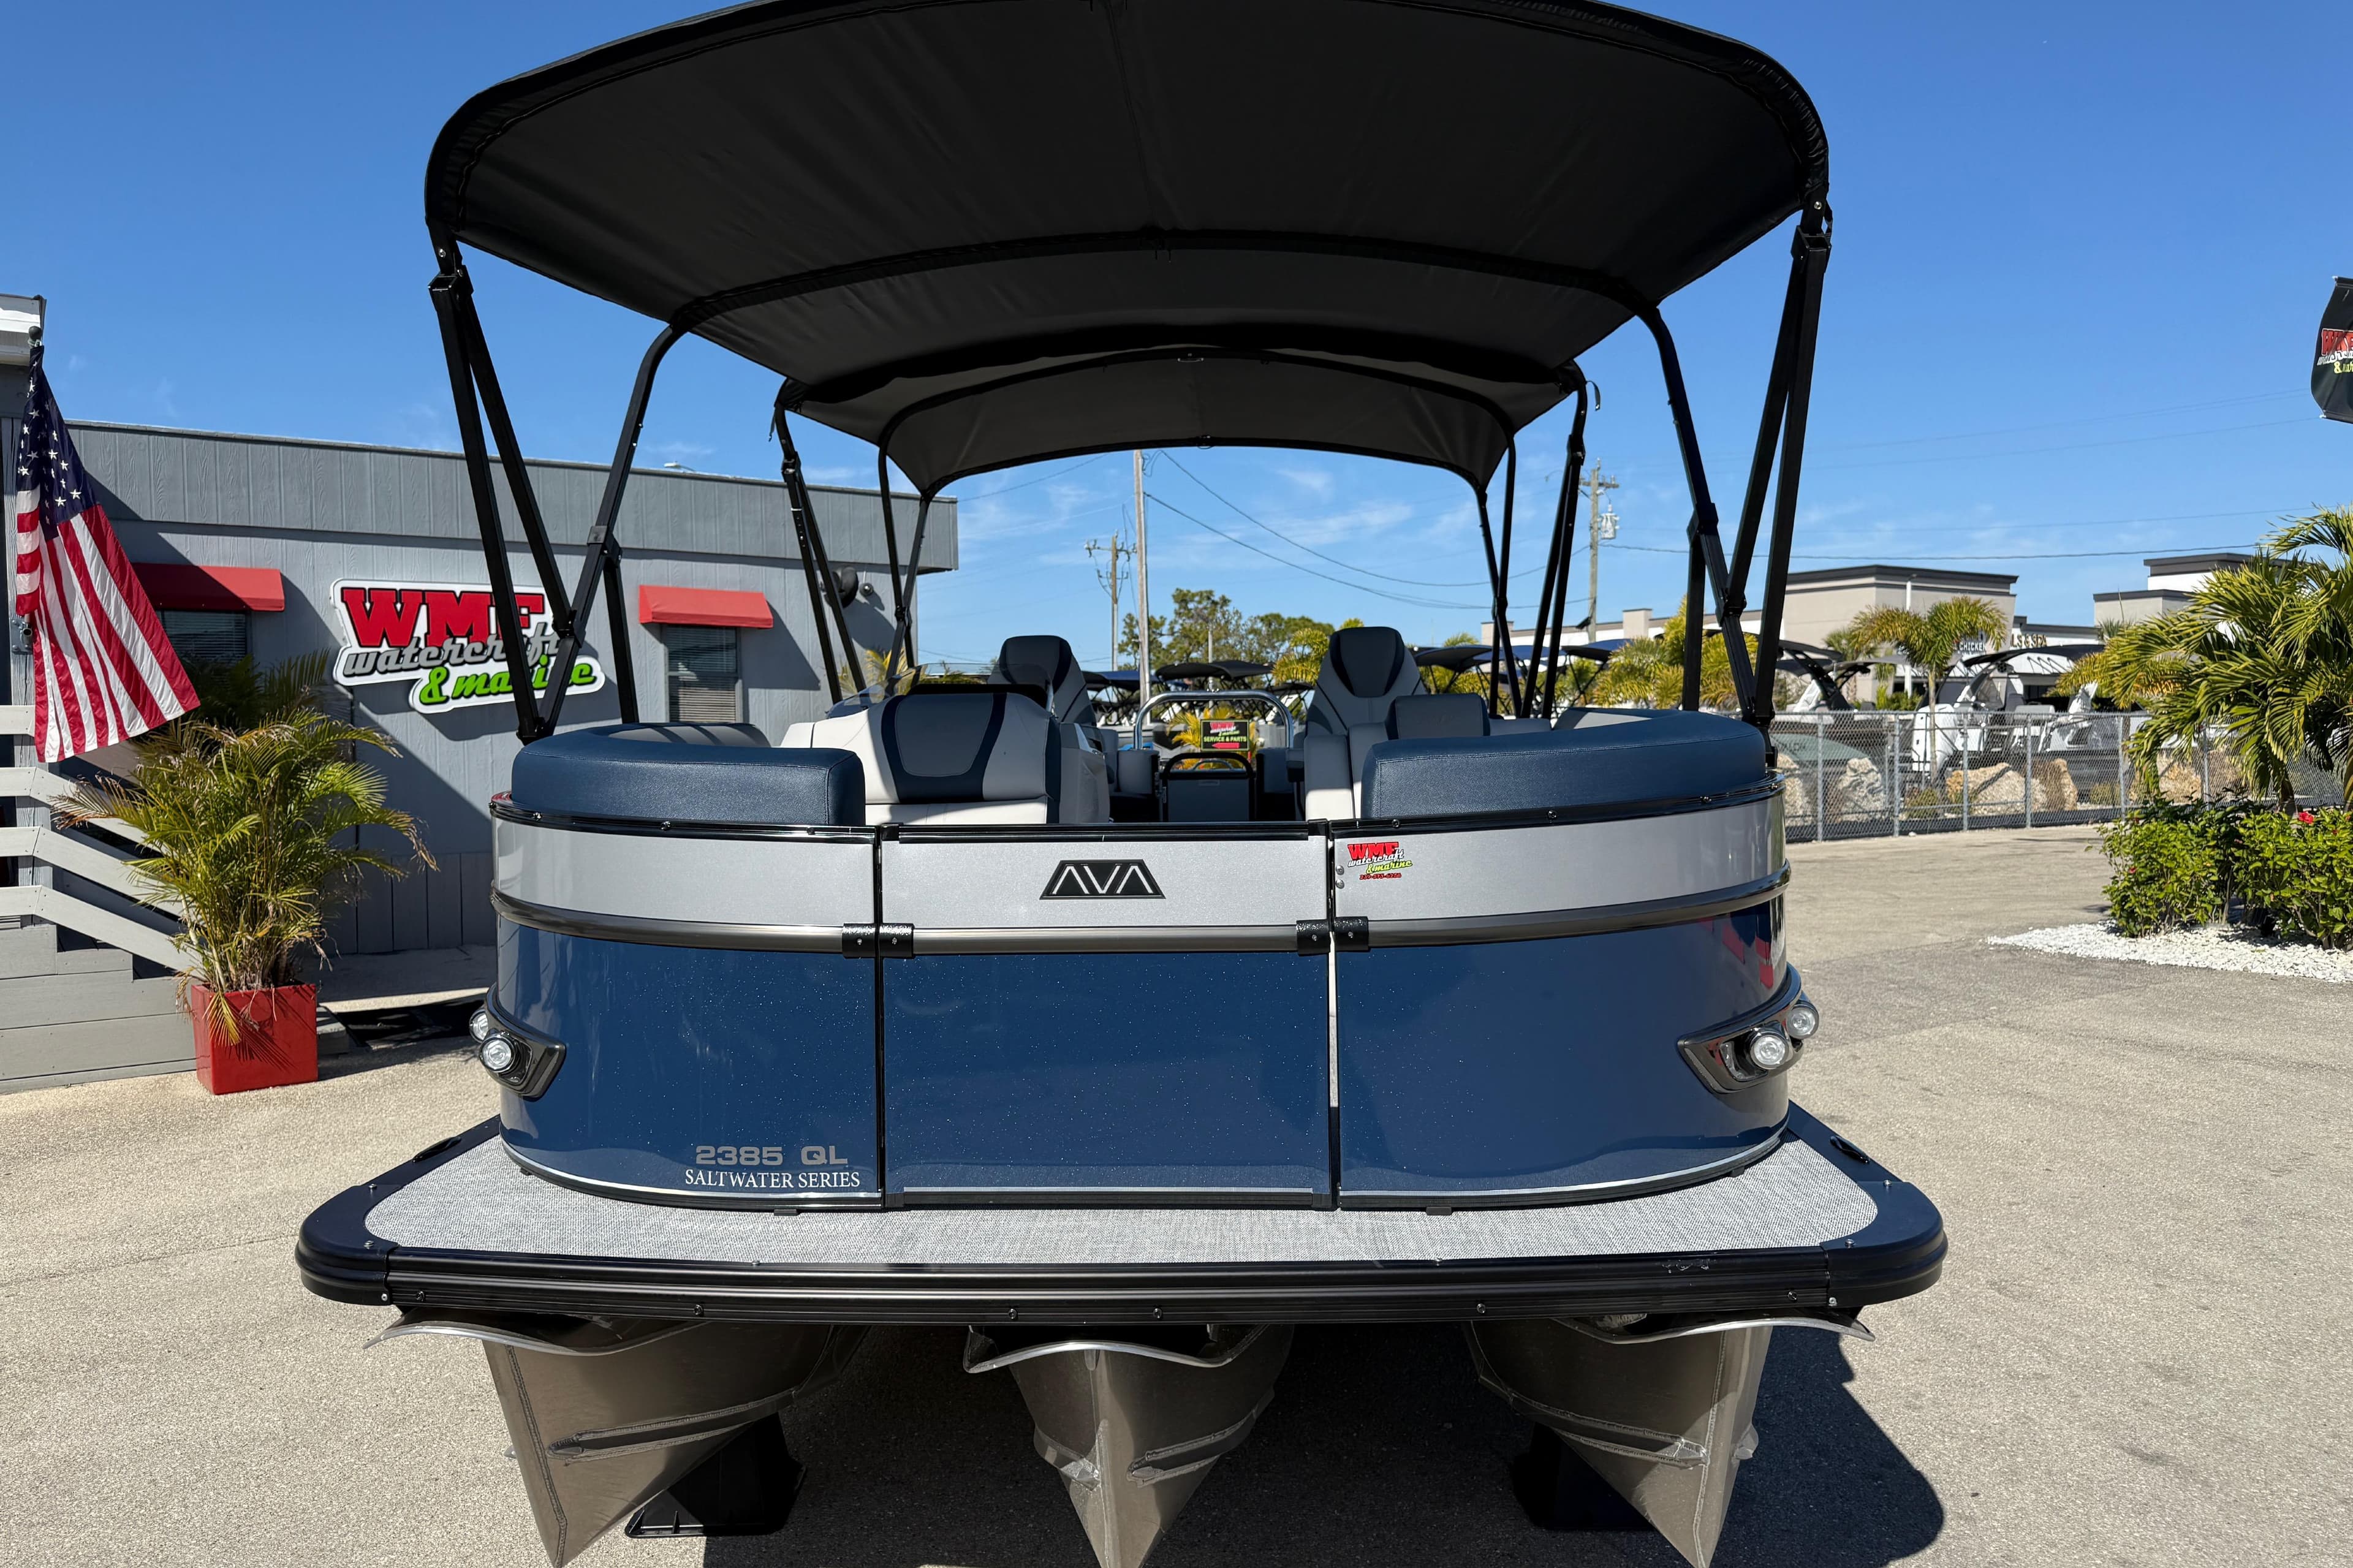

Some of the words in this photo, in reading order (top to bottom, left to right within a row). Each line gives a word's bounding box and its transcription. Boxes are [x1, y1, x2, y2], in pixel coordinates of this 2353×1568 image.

[343, 621, 561, 676] watercrft
[1959, 642, 1987, 651] CHICKEN
[419, 666, 447, 705] &
[451, 654, 597, 698] maie
[1347, 842, 1399, 860] WMF
[1348, 849, 1404, 868] watercraft
[1366, 863, 1373, 874] &
[1373, 860, 1412, 872] marine
[695, 1145, 783, 1165] 2385
[800, 1145, 848, 1165] QL
[684, 1168, 795, 1189] SALTWATER
[798, 1172, 860, 1189] SERIES
